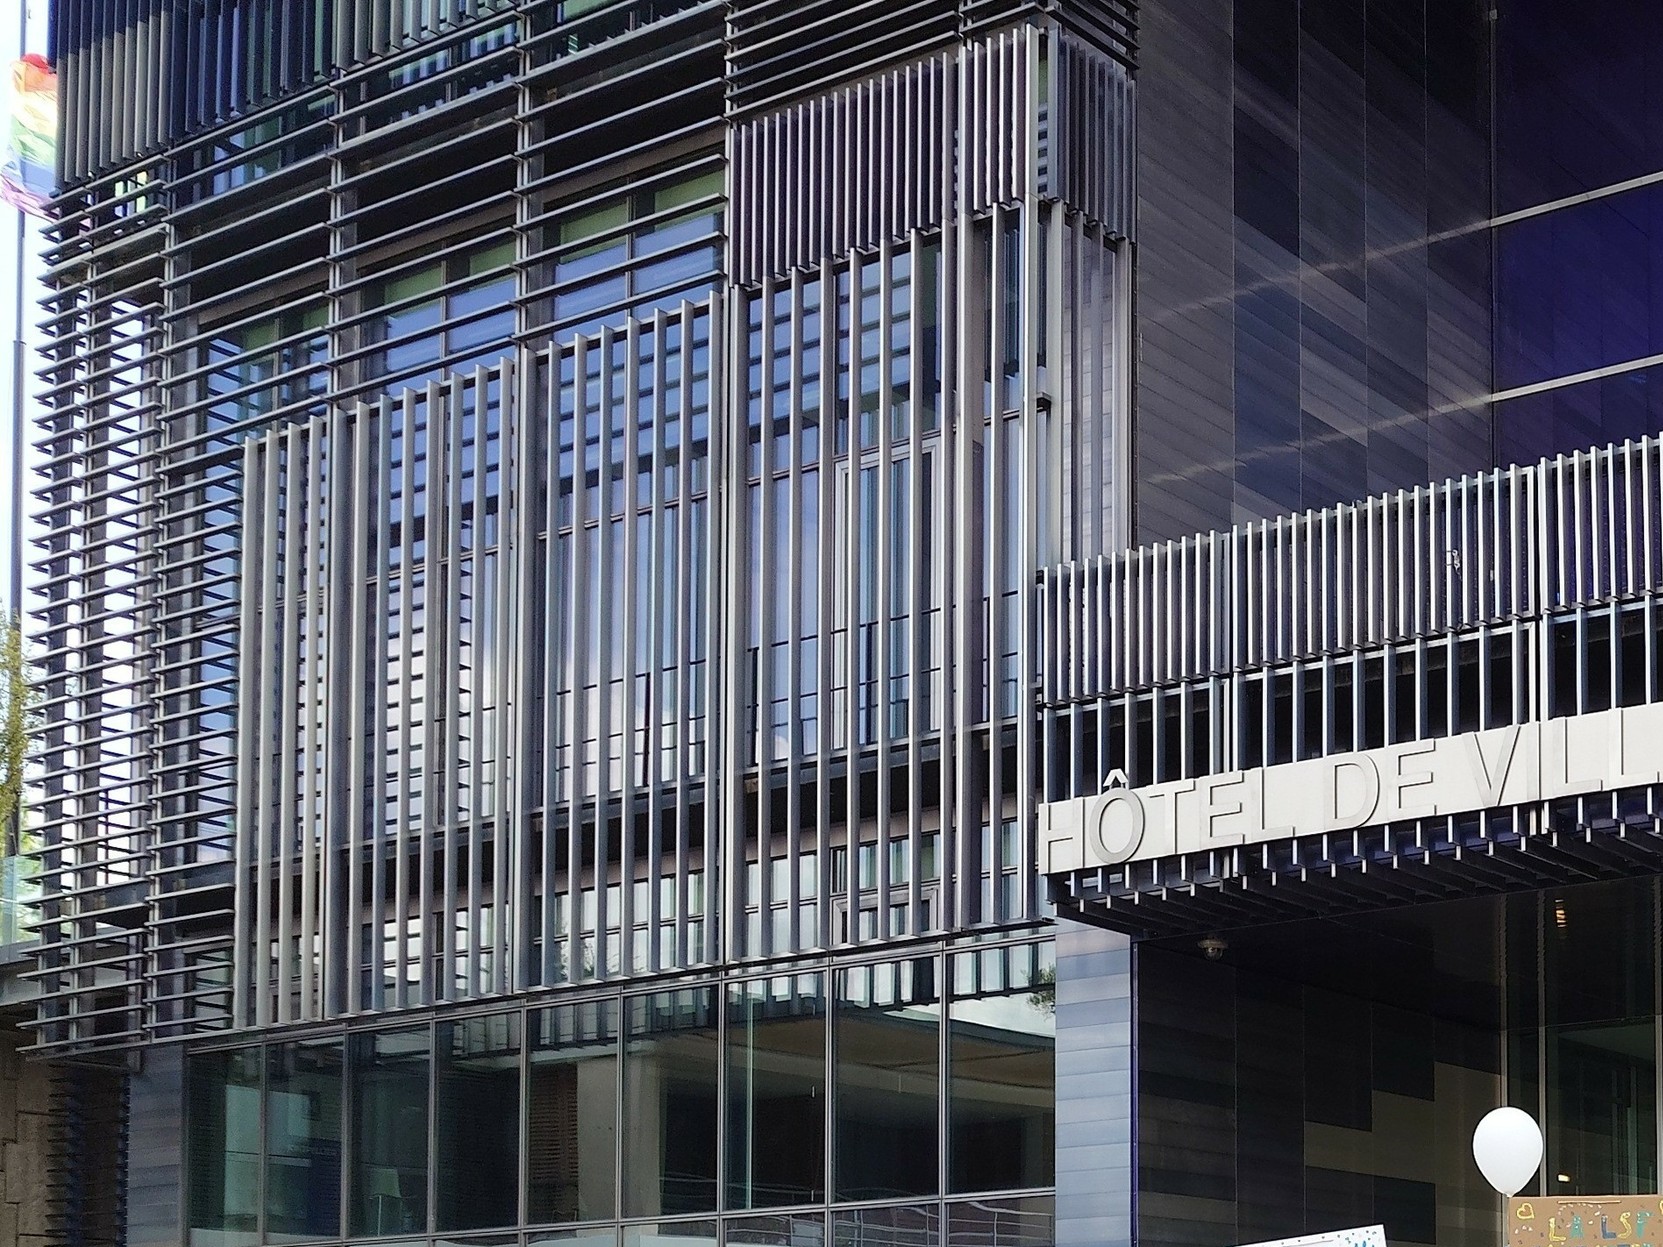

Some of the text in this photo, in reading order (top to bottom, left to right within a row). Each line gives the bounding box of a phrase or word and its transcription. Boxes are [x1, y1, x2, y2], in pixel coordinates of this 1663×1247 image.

[1039, 767, 1295, 875] HÔTEL
[1332, 738, 1437, 830] DE
[1549, 1211, 1652, 1242] LA LSF
